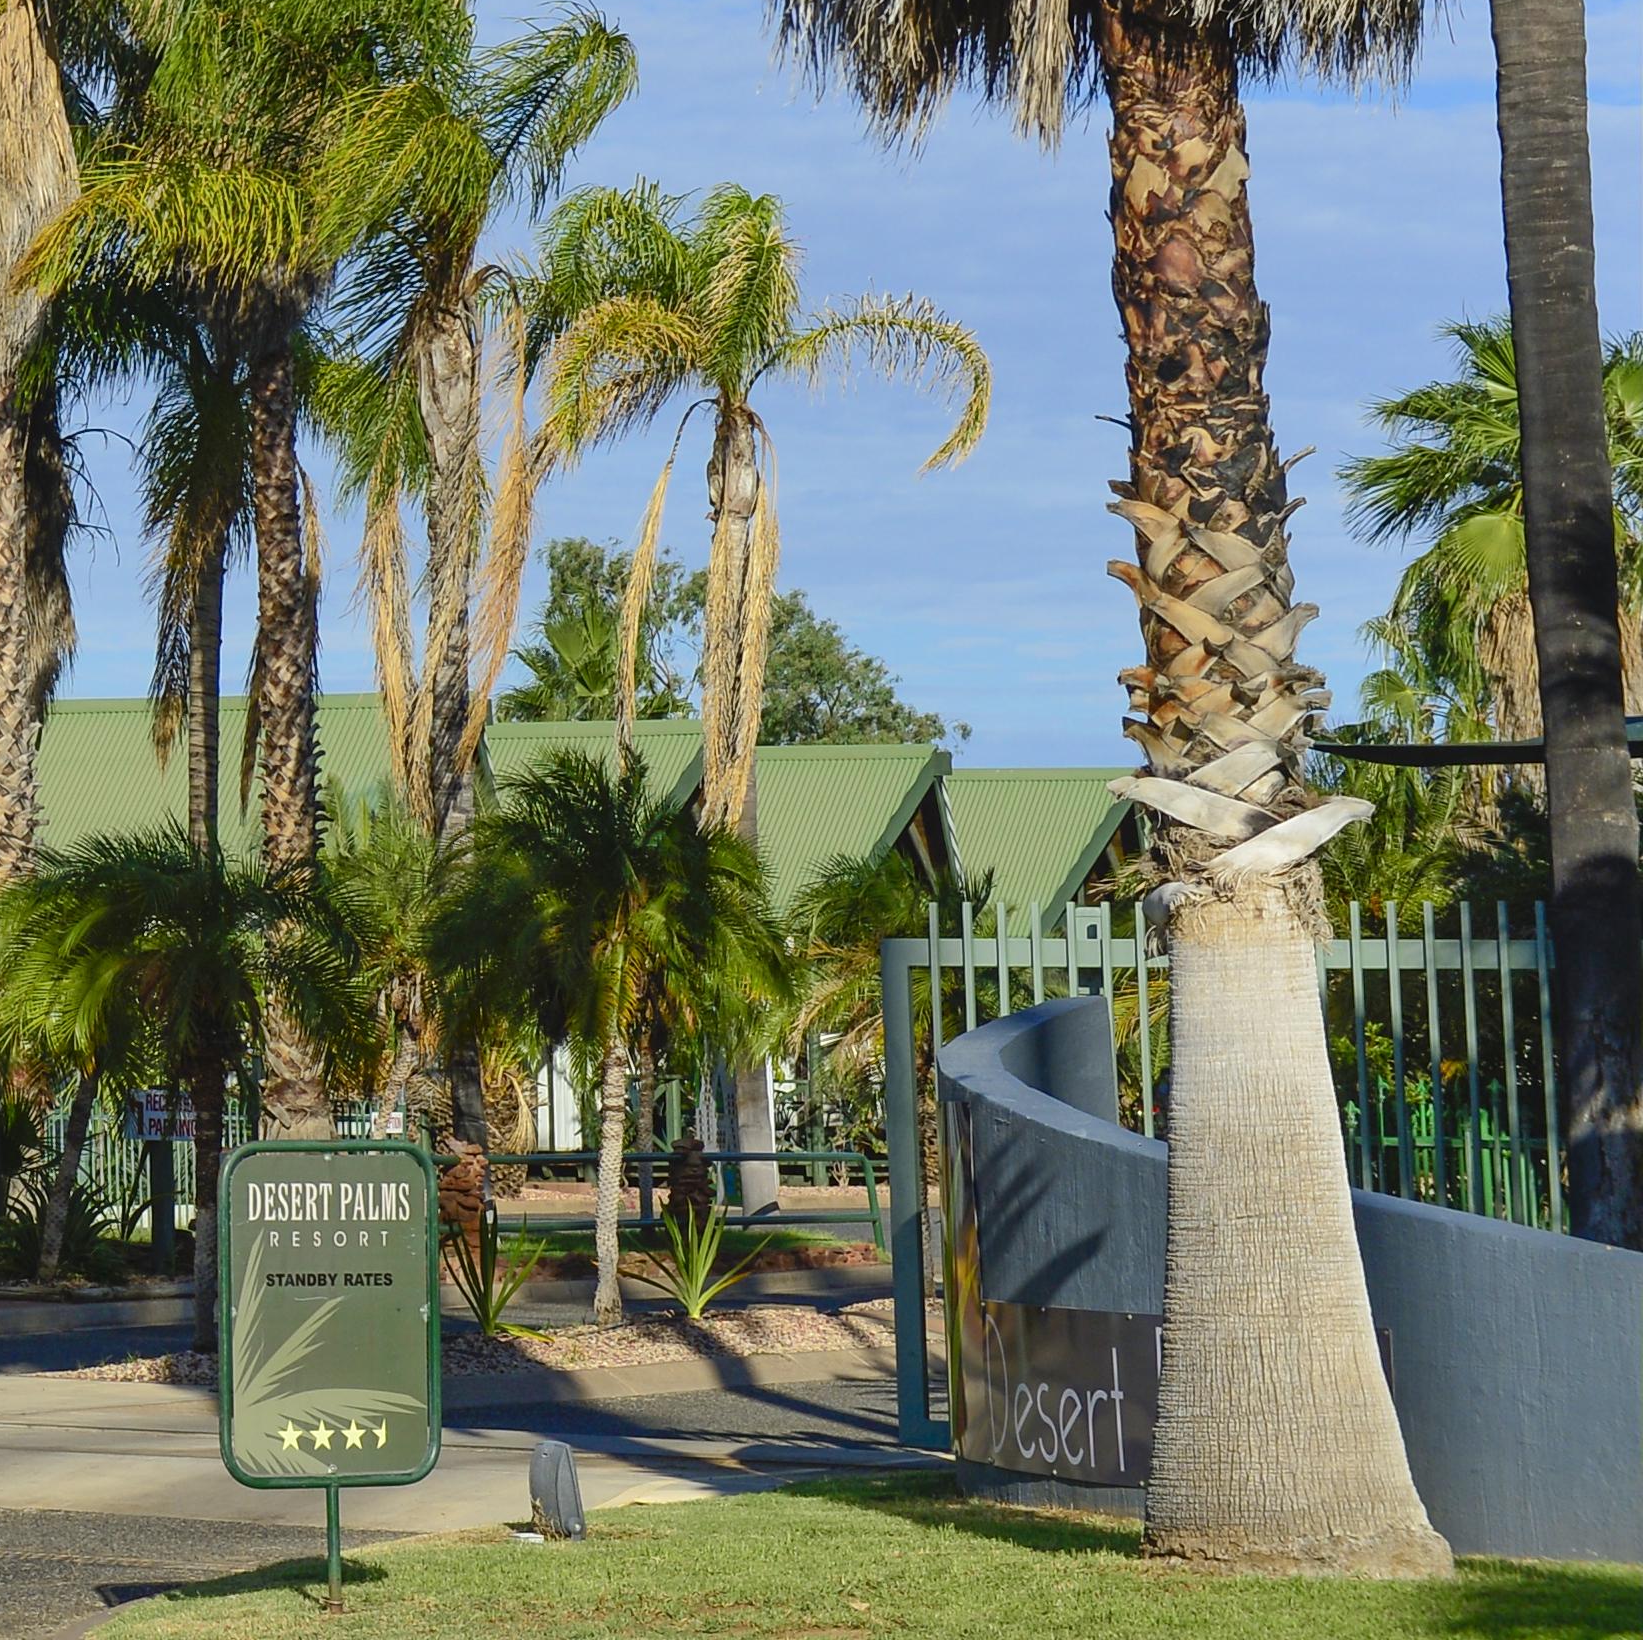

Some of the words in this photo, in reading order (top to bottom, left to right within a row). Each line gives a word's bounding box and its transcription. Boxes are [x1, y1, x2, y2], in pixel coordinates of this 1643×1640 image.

[248, 1182, 333, 1222] DESERT
[339, 1182, 410, 1221] PALMS
[270, 1231, 389, 1247] RESORT
[266, 1273, 339, 1287] STANDBY
[343, 1273, 393, 1287] RATES
[985, 1313, 1125, 1472] Desert
